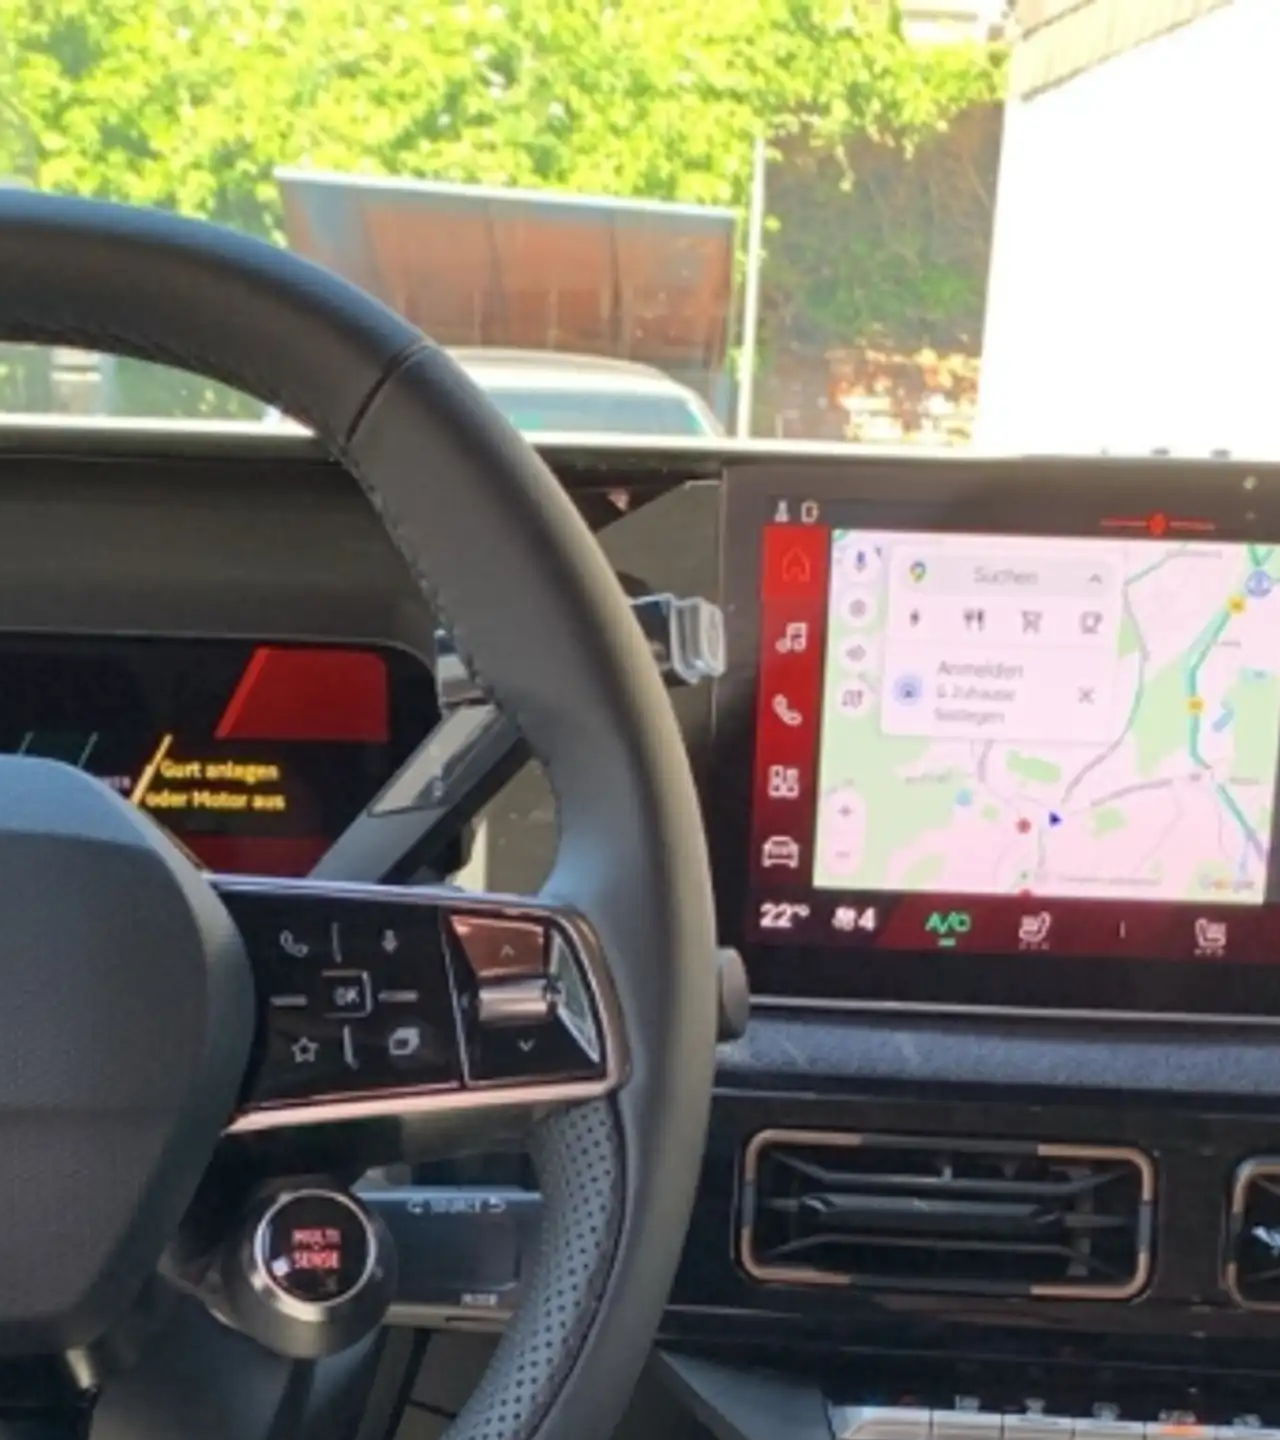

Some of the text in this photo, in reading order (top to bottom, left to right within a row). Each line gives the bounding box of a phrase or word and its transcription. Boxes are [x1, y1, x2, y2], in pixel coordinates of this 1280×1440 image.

[973, 566, 1039, 586] Suchen
[936, 660, 1024, 679] Anmelden
[159, 760, 280, 784] Gurt anlegen
[145, 789, 286, 810] oder Motor aus
[923, 910, 972, 935] A/C
[333, 985, 362, 1006] OK
